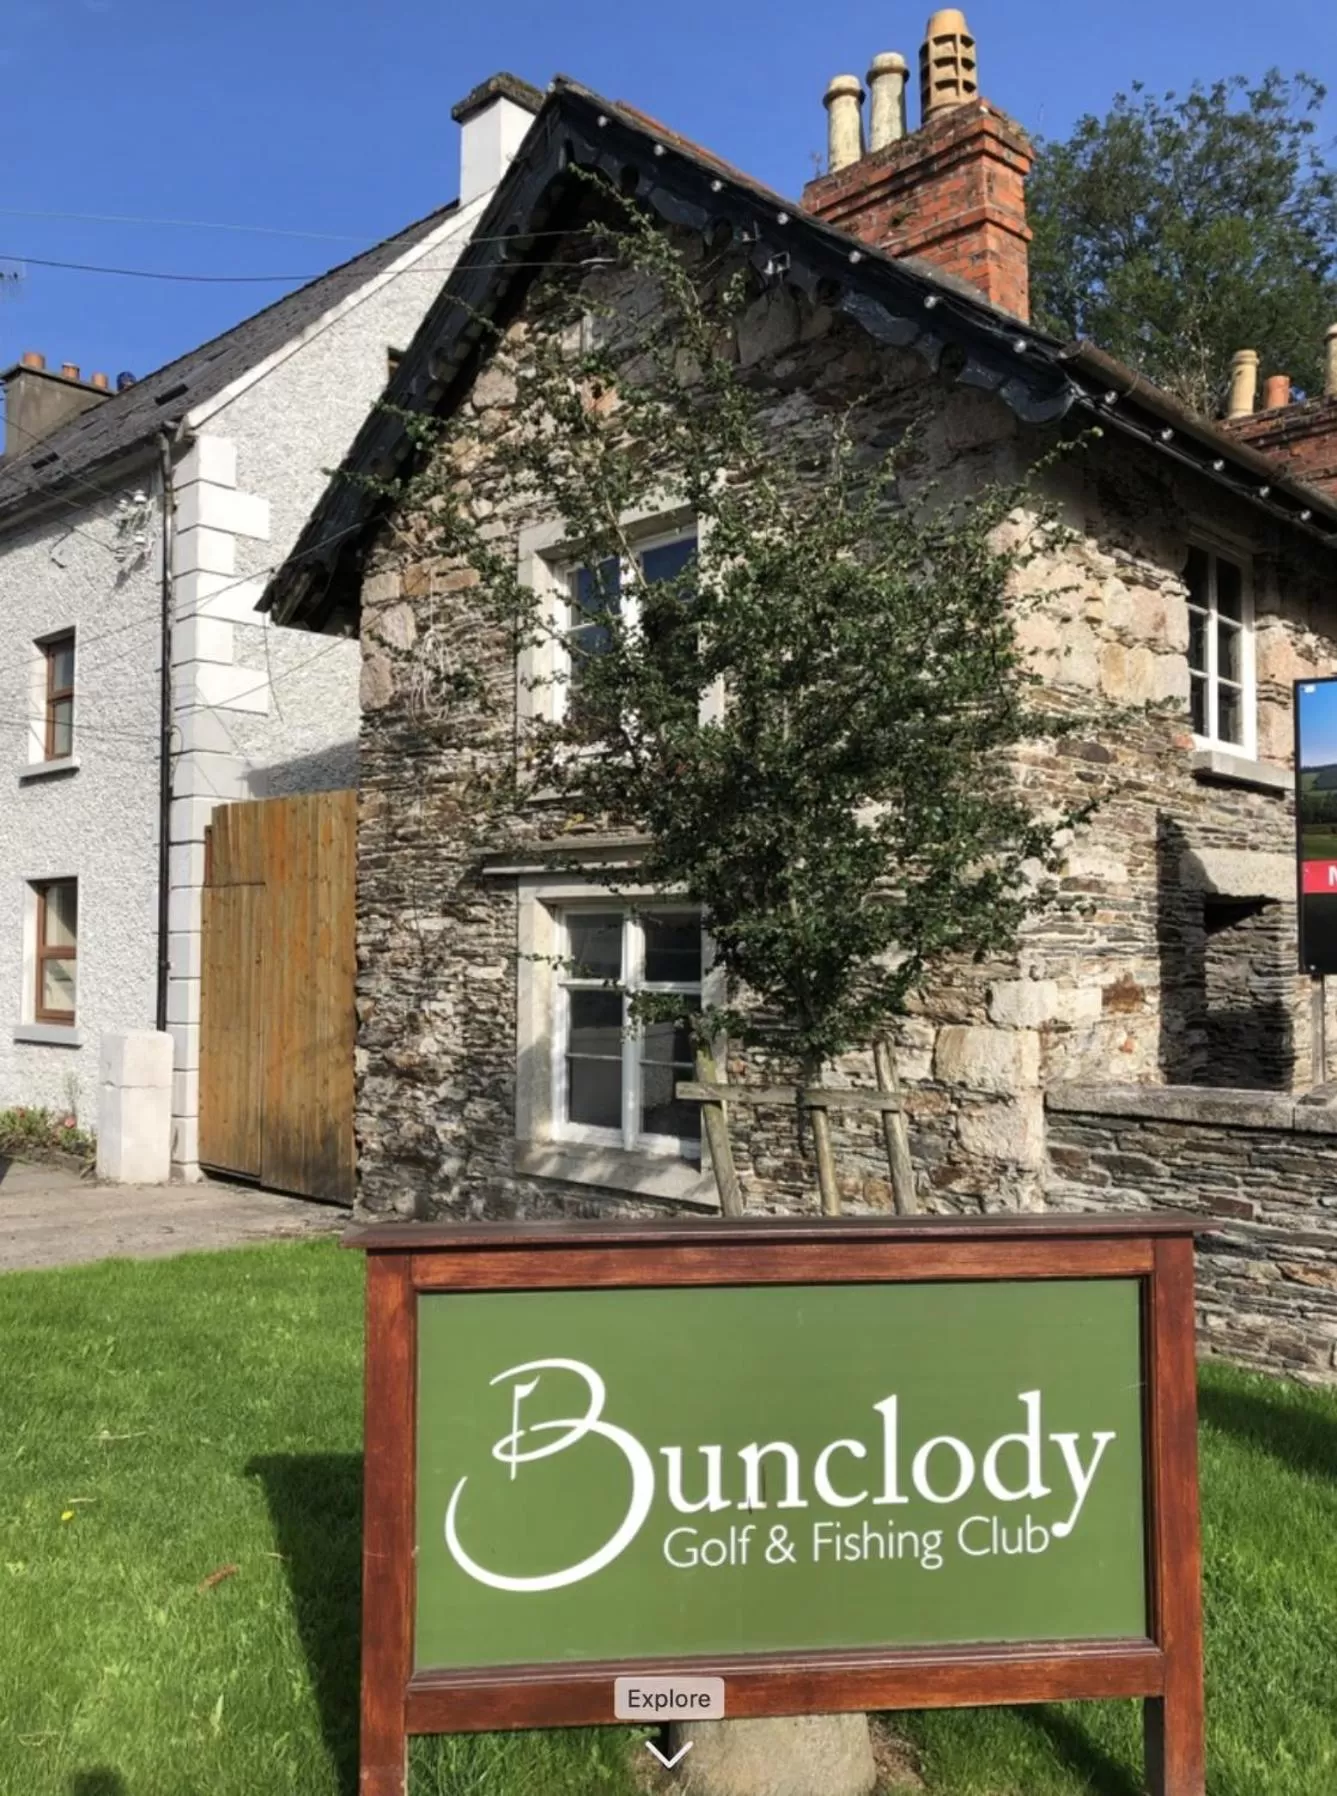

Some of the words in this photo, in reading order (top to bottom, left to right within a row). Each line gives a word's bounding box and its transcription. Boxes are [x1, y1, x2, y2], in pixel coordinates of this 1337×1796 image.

[444, 1358, 1116, 1592] Bunclody
[663, 1524, 756, 1568] Golf
[765, 1524, 796, 1564] &
[813, 1520, 943, 1570] Fishing
[958, 1514, 1050, 1556] Club
